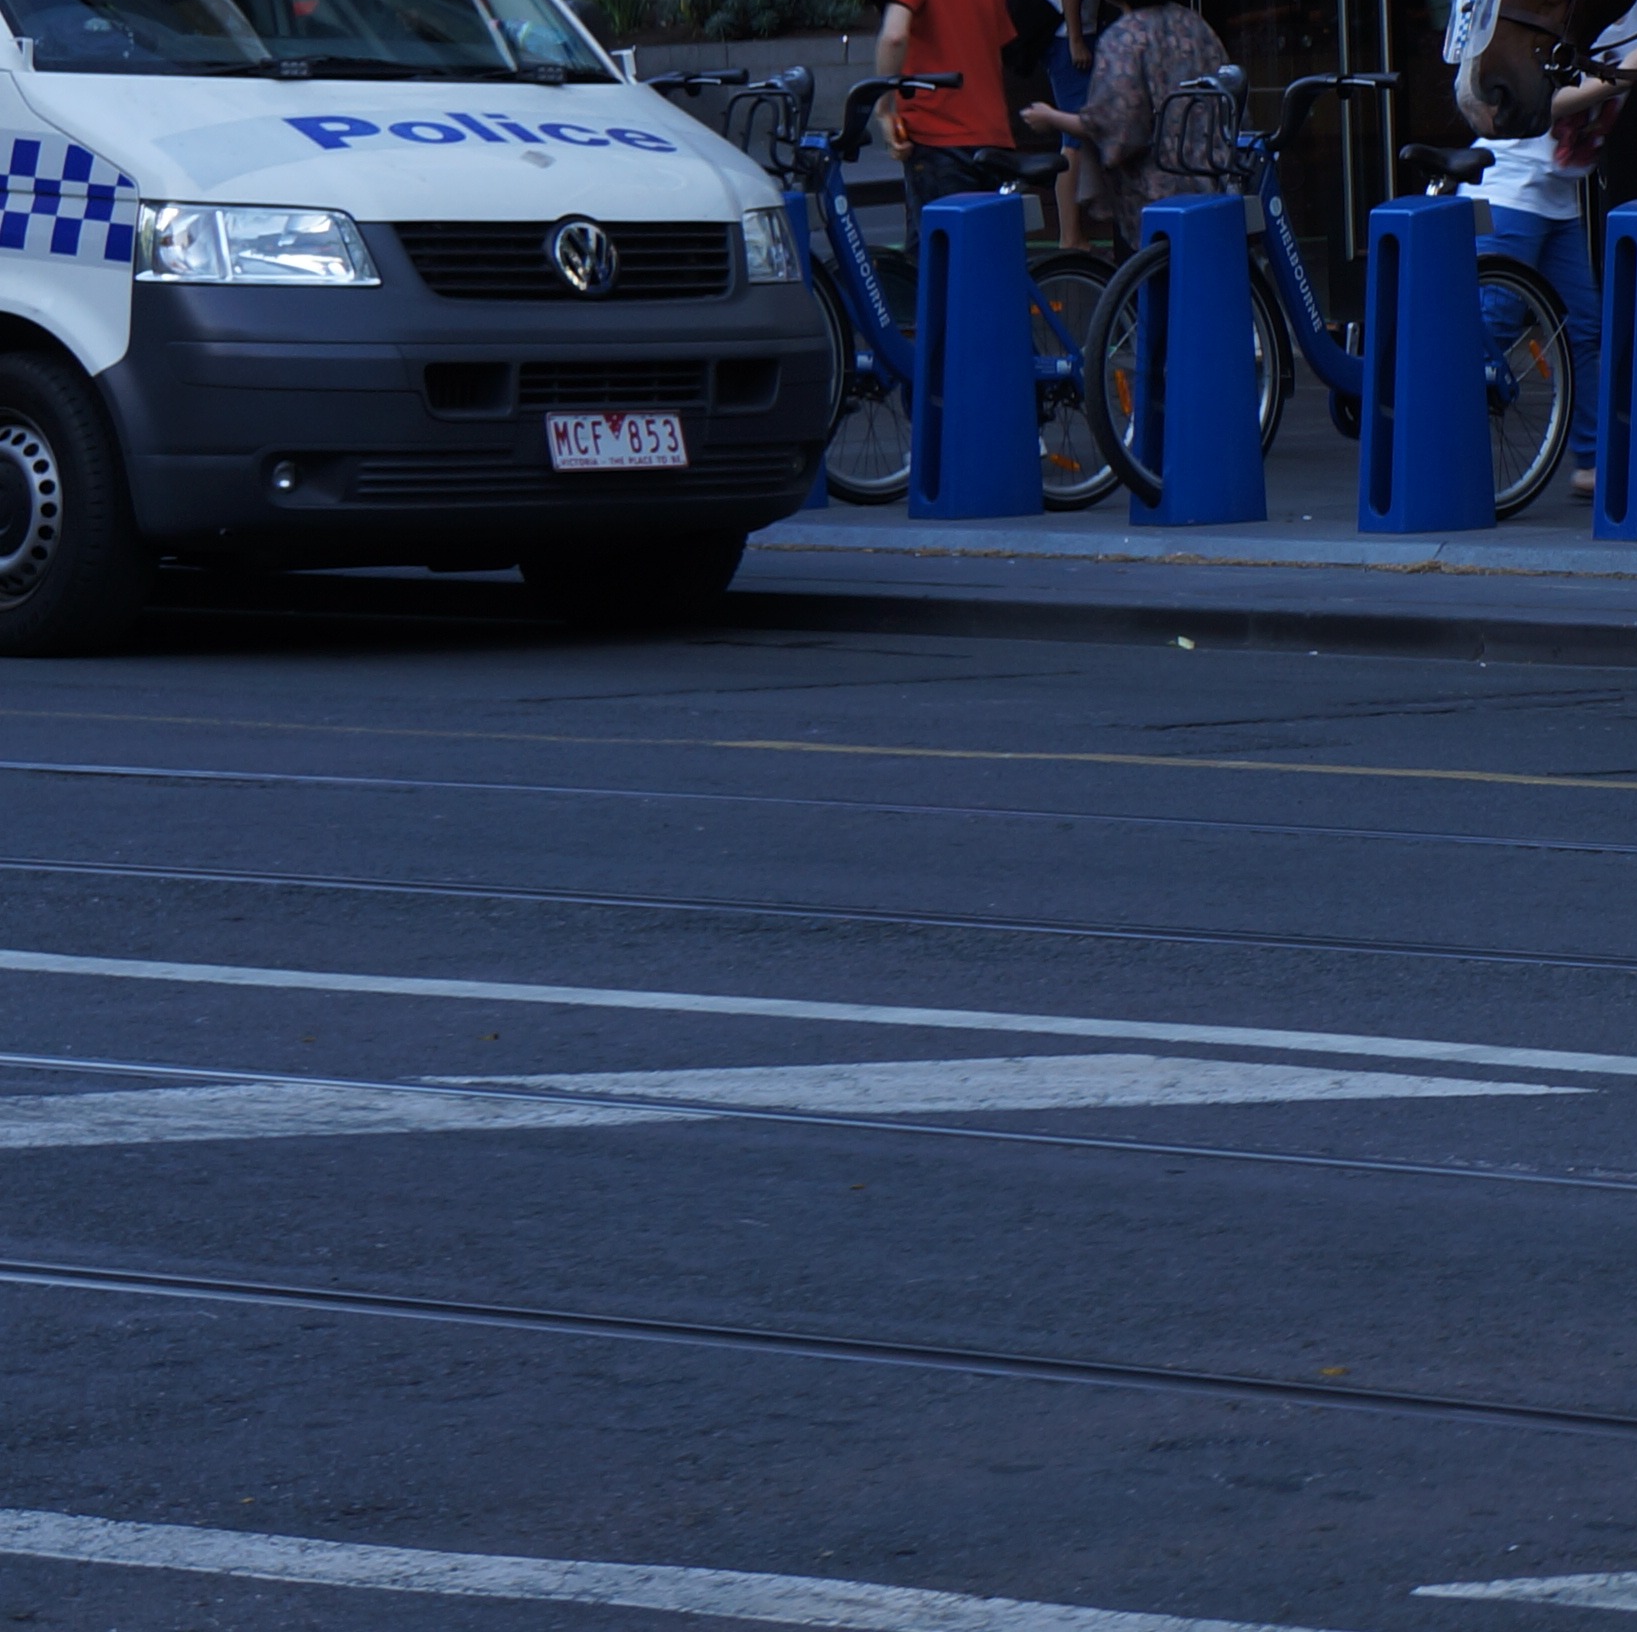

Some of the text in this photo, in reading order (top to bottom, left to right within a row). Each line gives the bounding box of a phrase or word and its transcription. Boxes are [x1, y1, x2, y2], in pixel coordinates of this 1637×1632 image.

[282, 112, 677, 153] Police
[840, 214, 891, 329] MELBOURNE
[1276, 215, 1323, 333] MELBOURNE
[554, 419, 678, 456] MCF 853
[560, 457, 598, 467] VICTORIA
[609, 456, 625, 466] THE
[628, 455, 652, 465] PLACE
[657, 455, 667, 464] TO
